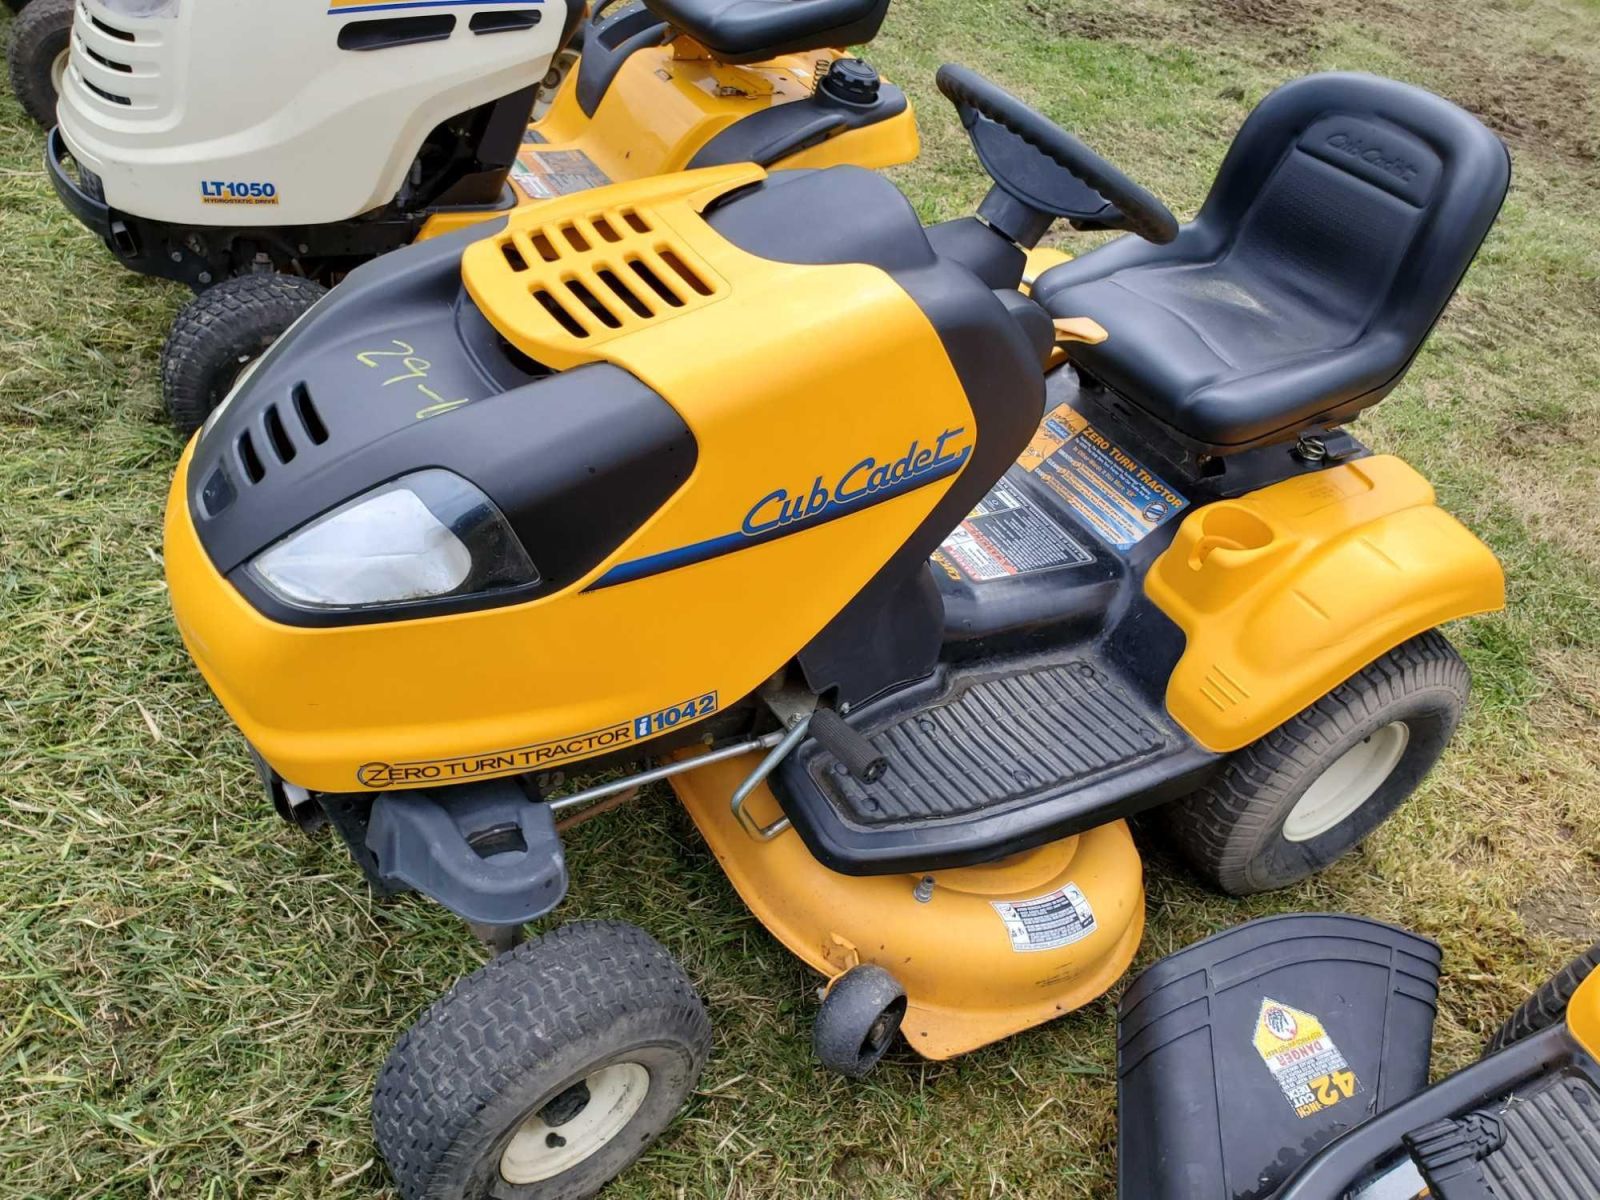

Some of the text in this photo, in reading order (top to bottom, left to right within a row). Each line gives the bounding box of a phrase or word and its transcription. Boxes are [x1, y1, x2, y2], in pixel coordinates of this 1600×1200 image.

[201, 180, 276, 197] LT1050
[740, 427, 966, 537] Cub Cadet
[1082, 426, 1110, 450] ZERO
[1109, 447, 1138, 473] TURN
[1136, 467, 1185, 509] TRACTOR
[356, 760, 442, 789] ZERO
[450, 754, 516, 777] TURN
[518, 725, 631, 767] TRACTOR
[1275, 1040, 1324, 1067] DANGER
[1287, 1084, 1311, 1101] DECK
[1293, 1092, 1316, 1109] CUT
[1295, 1070, 1356, 1119] 42 INCH
